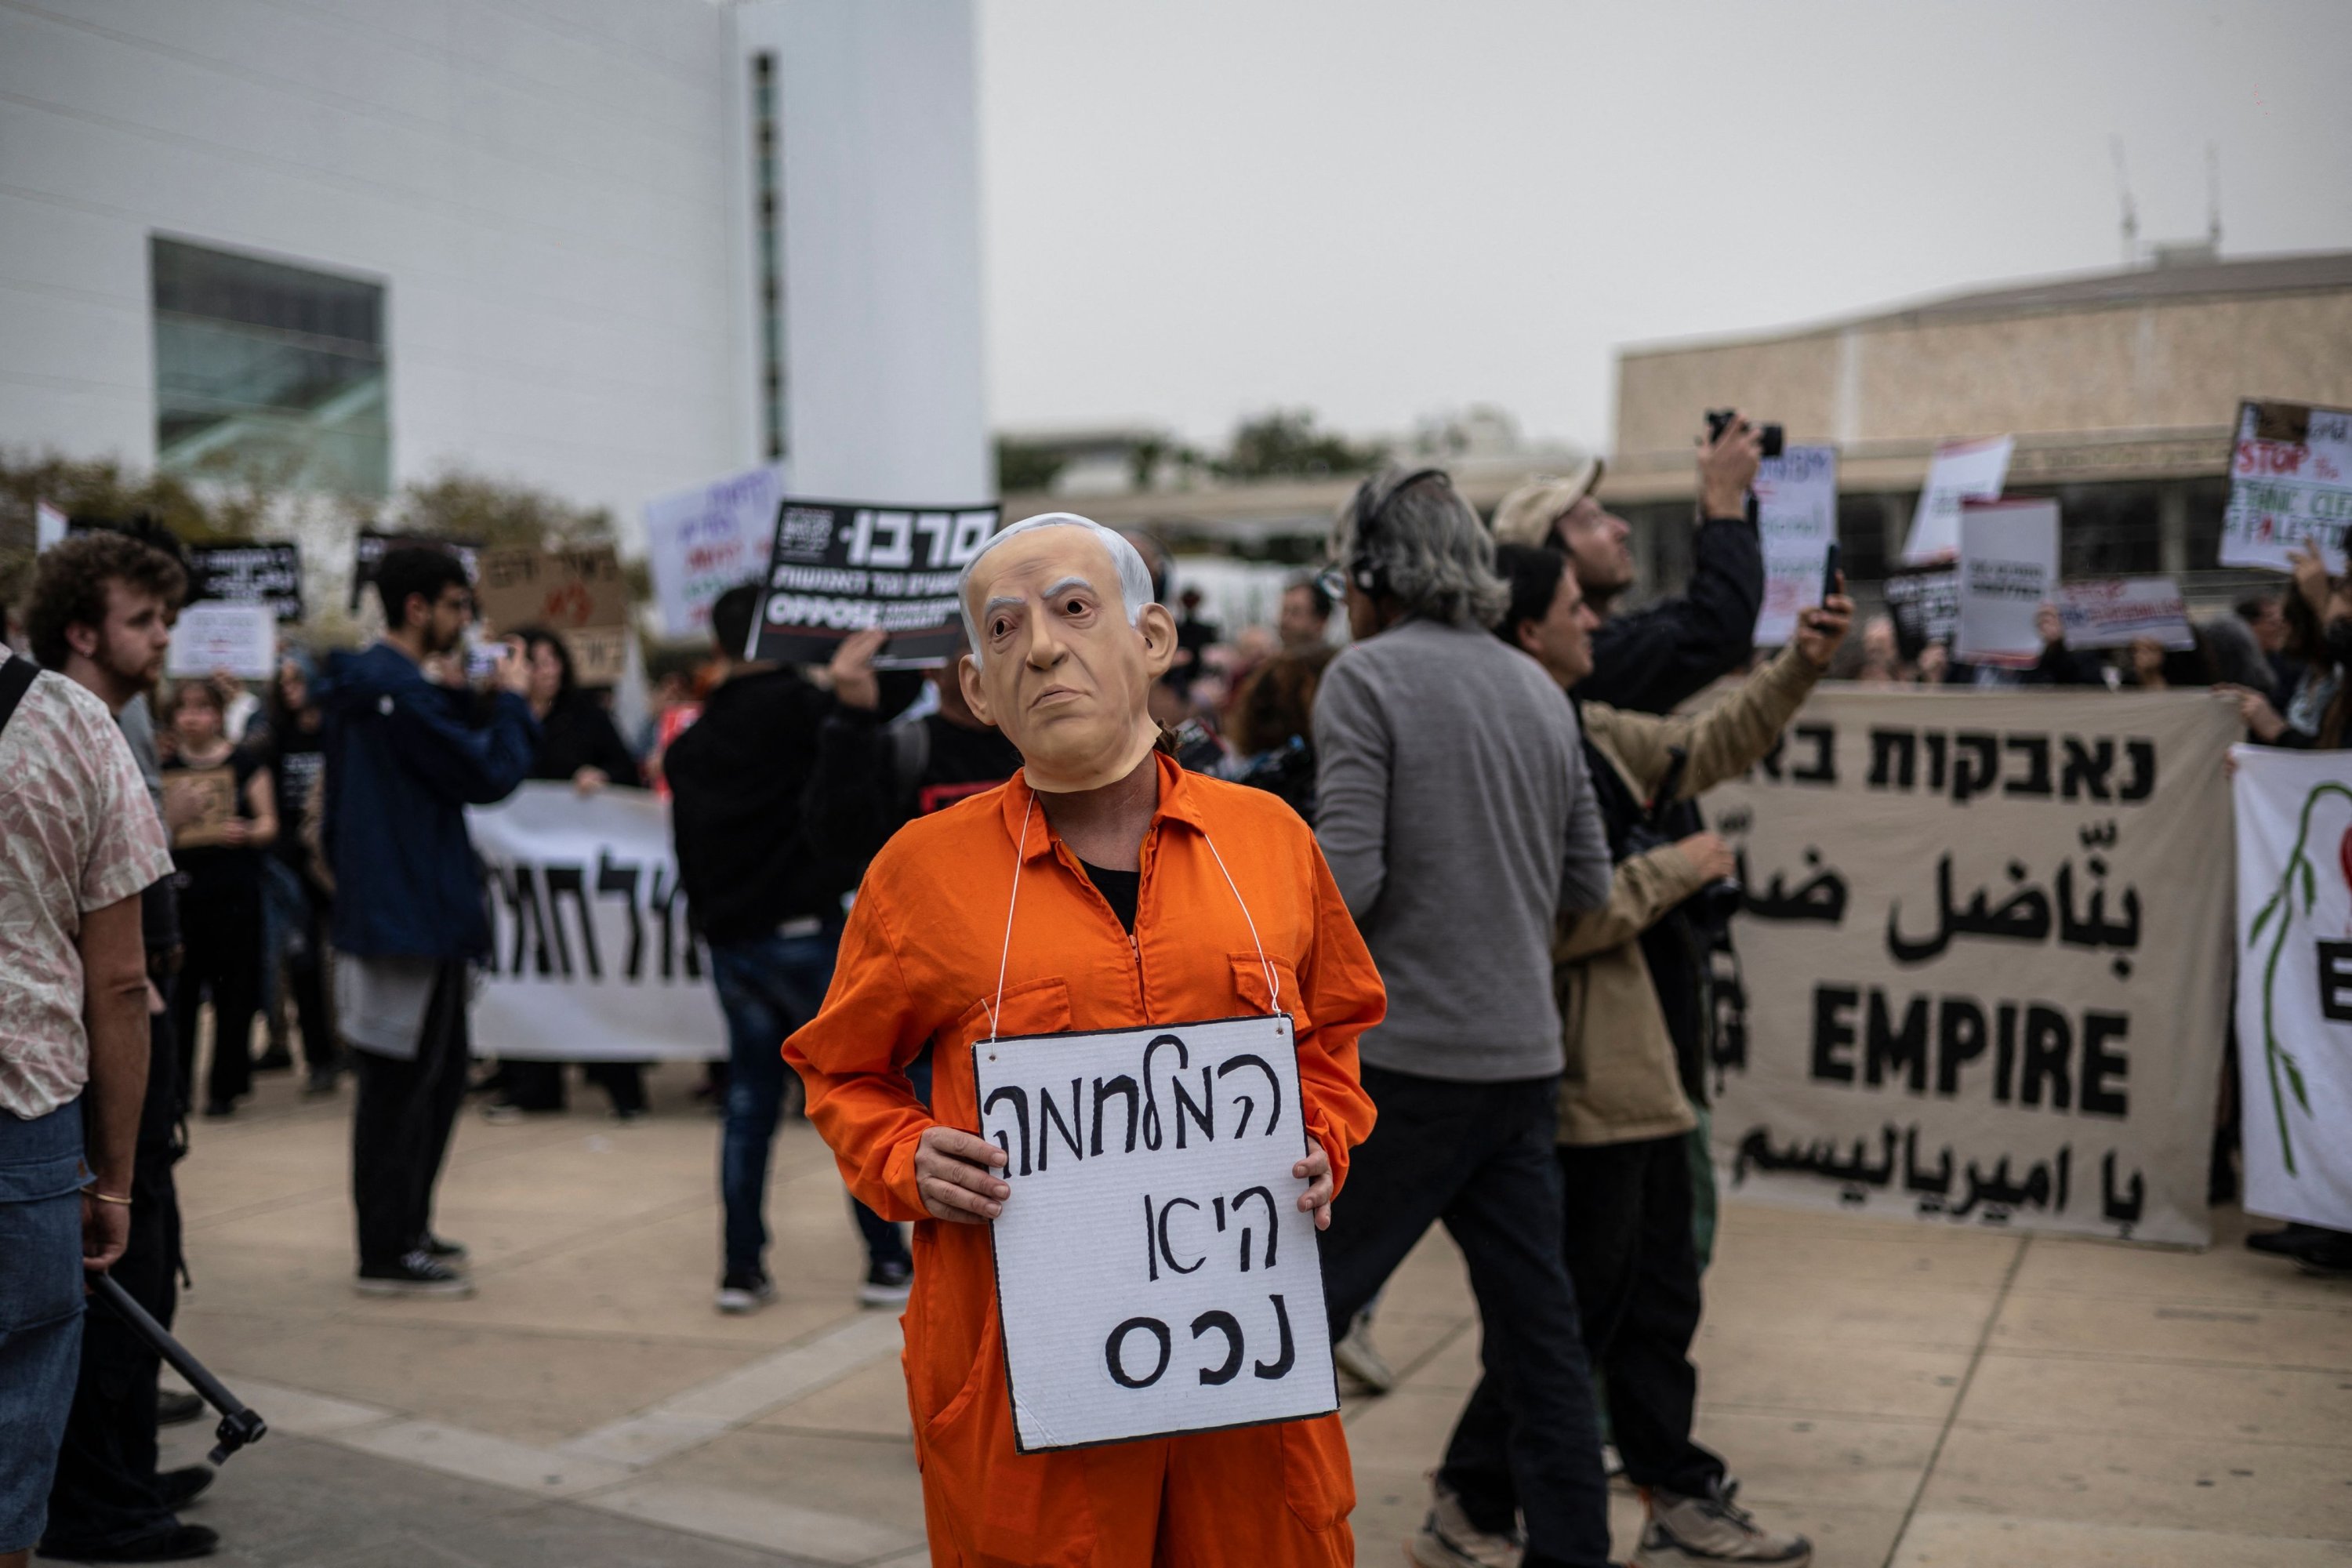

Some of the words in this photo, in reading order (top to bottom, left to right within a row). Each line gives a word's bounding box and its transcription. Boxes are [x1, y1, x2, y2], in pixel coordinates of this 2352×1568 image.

[2238, 440, 2310, 475] STOP
[2309, 488, 2352, 520] CLE
[765, 591, 881, 630] OPPOSE
[1867, 724, 2157, 807] נאבקות
[1812, 980, 2131, 1120] EMPIRE
[983, 1034, 1281, 1179] המלחמה
[1144, 1185, 1279, 1282] היא
[1105, 1294, 1296, 1389] נכס
